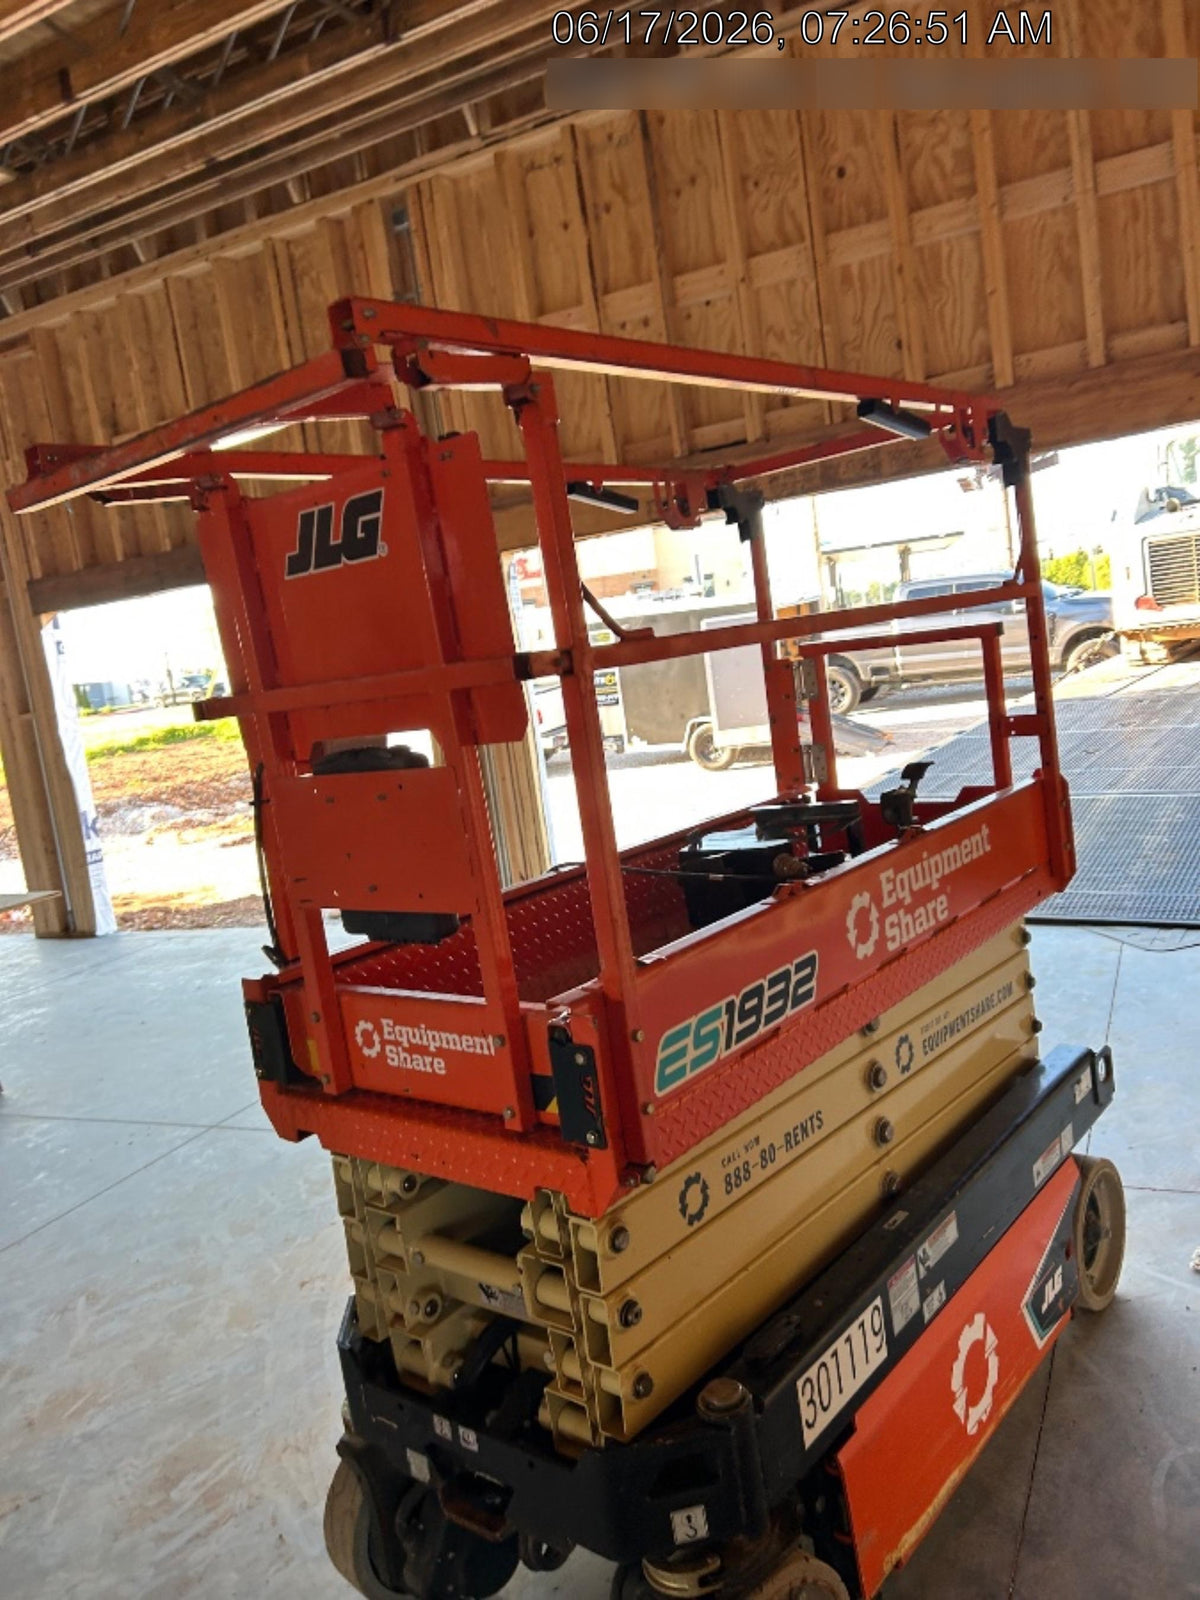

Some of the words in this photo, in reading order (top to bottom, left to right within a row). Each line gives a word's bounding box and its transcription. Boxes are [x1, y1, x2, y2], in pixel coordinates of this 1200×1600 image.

[284, 487, 386, 580] JLG
[879, 823, 992, 908] Equipment
[884, 893, 949, 951] Share
[380, 1018, 496, 1056] Equipment
[385, 1044, 446, 1074] Share
[654, 950, 818, 1097] ES1932
[922, 981, 1014, 1057] EQUIPMENTSHARE.COM
[724, 1109, 824, 1195] 888-80-RENTS
[801, 1303, 886, 1430] 301119
